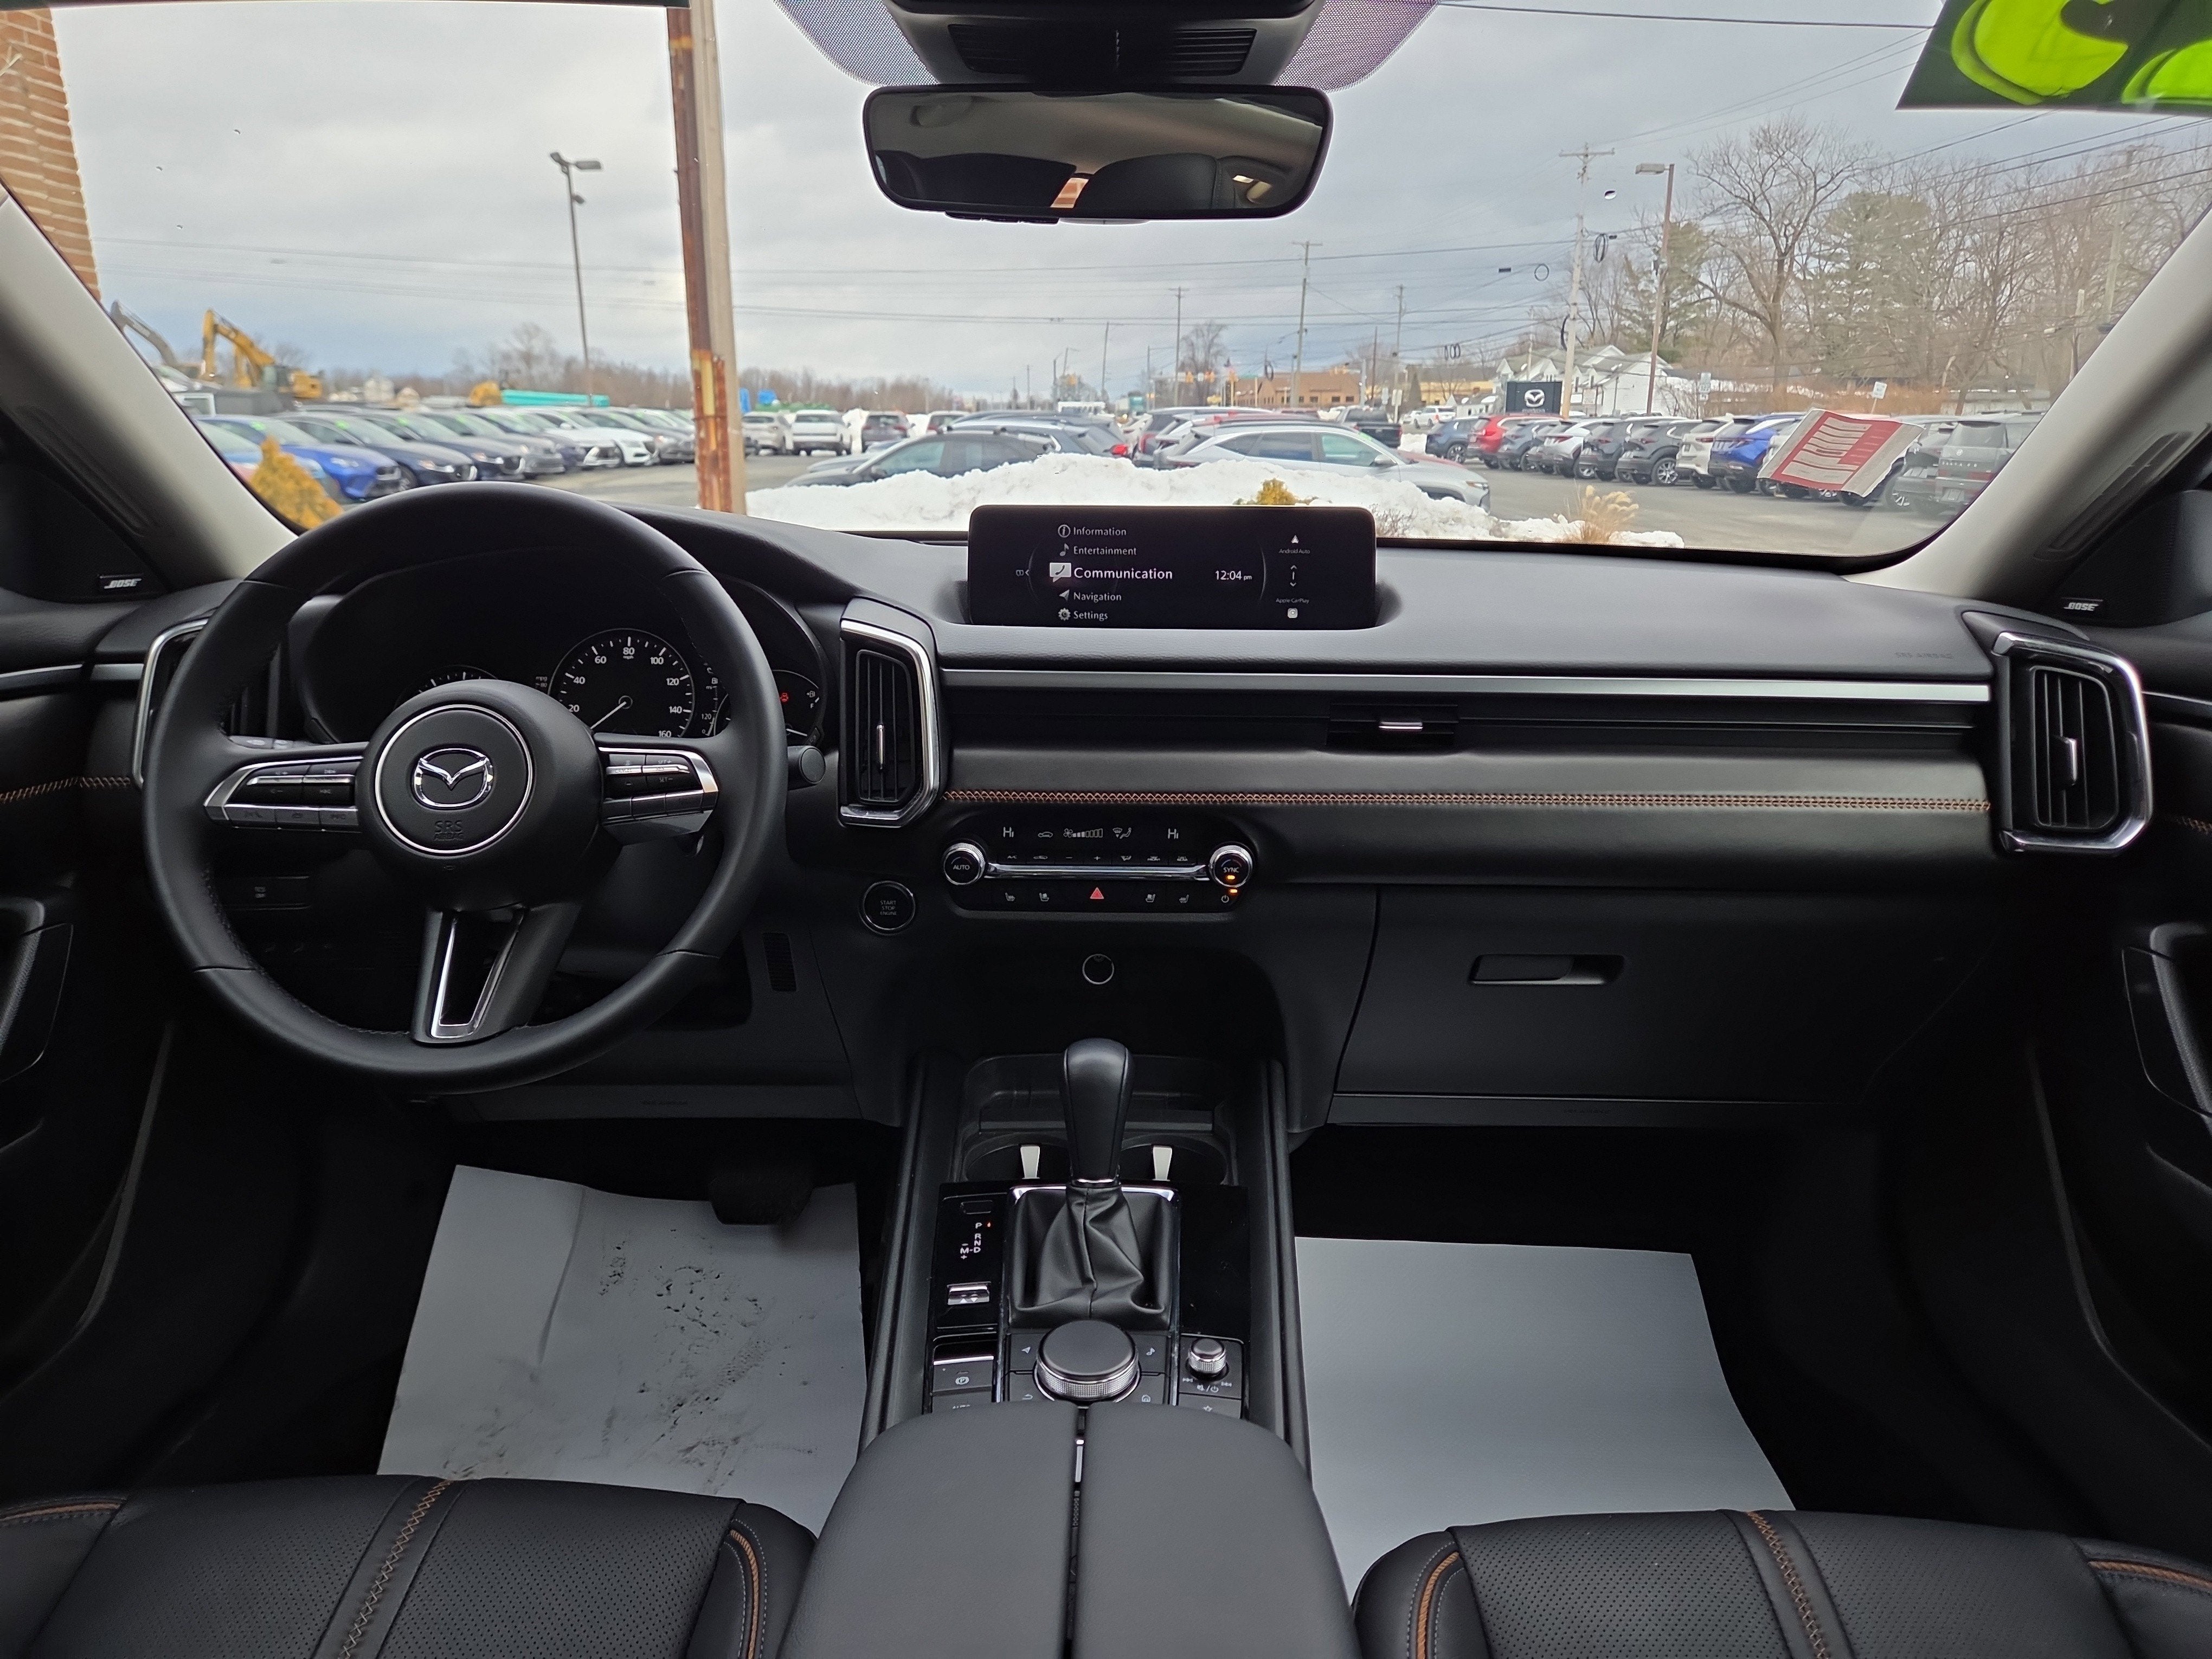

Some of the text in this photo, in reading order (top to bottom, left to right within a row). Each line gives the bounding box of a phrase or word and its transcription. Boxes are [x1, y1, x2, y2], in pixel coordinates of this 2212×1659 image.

[1073, 526, 1127, 536] Information
[1073, 545, 1137, 555] Entertainment
[1073, 567, 1173, 580] Communication
[1215, 570, 1243, 581] 12:04
[104, 578, 142, 589] BOSE
[1073, 592, 1122, 603] Navigation
[2063, 601, 2099, 612] BOSE
[1073, 610, 1108, 622] Settings
[622, 647, 635, 655] 80
[594, 655, 607, 664] 60
[650, 657, 664, 665] 100
[573, 676, 586, 685] 40
[666, 678, 679, 686] 120
[568, 704, 580, 712] 20
[669, 706, 682, 714] 140
[434, 820, 463, 833] SRS
